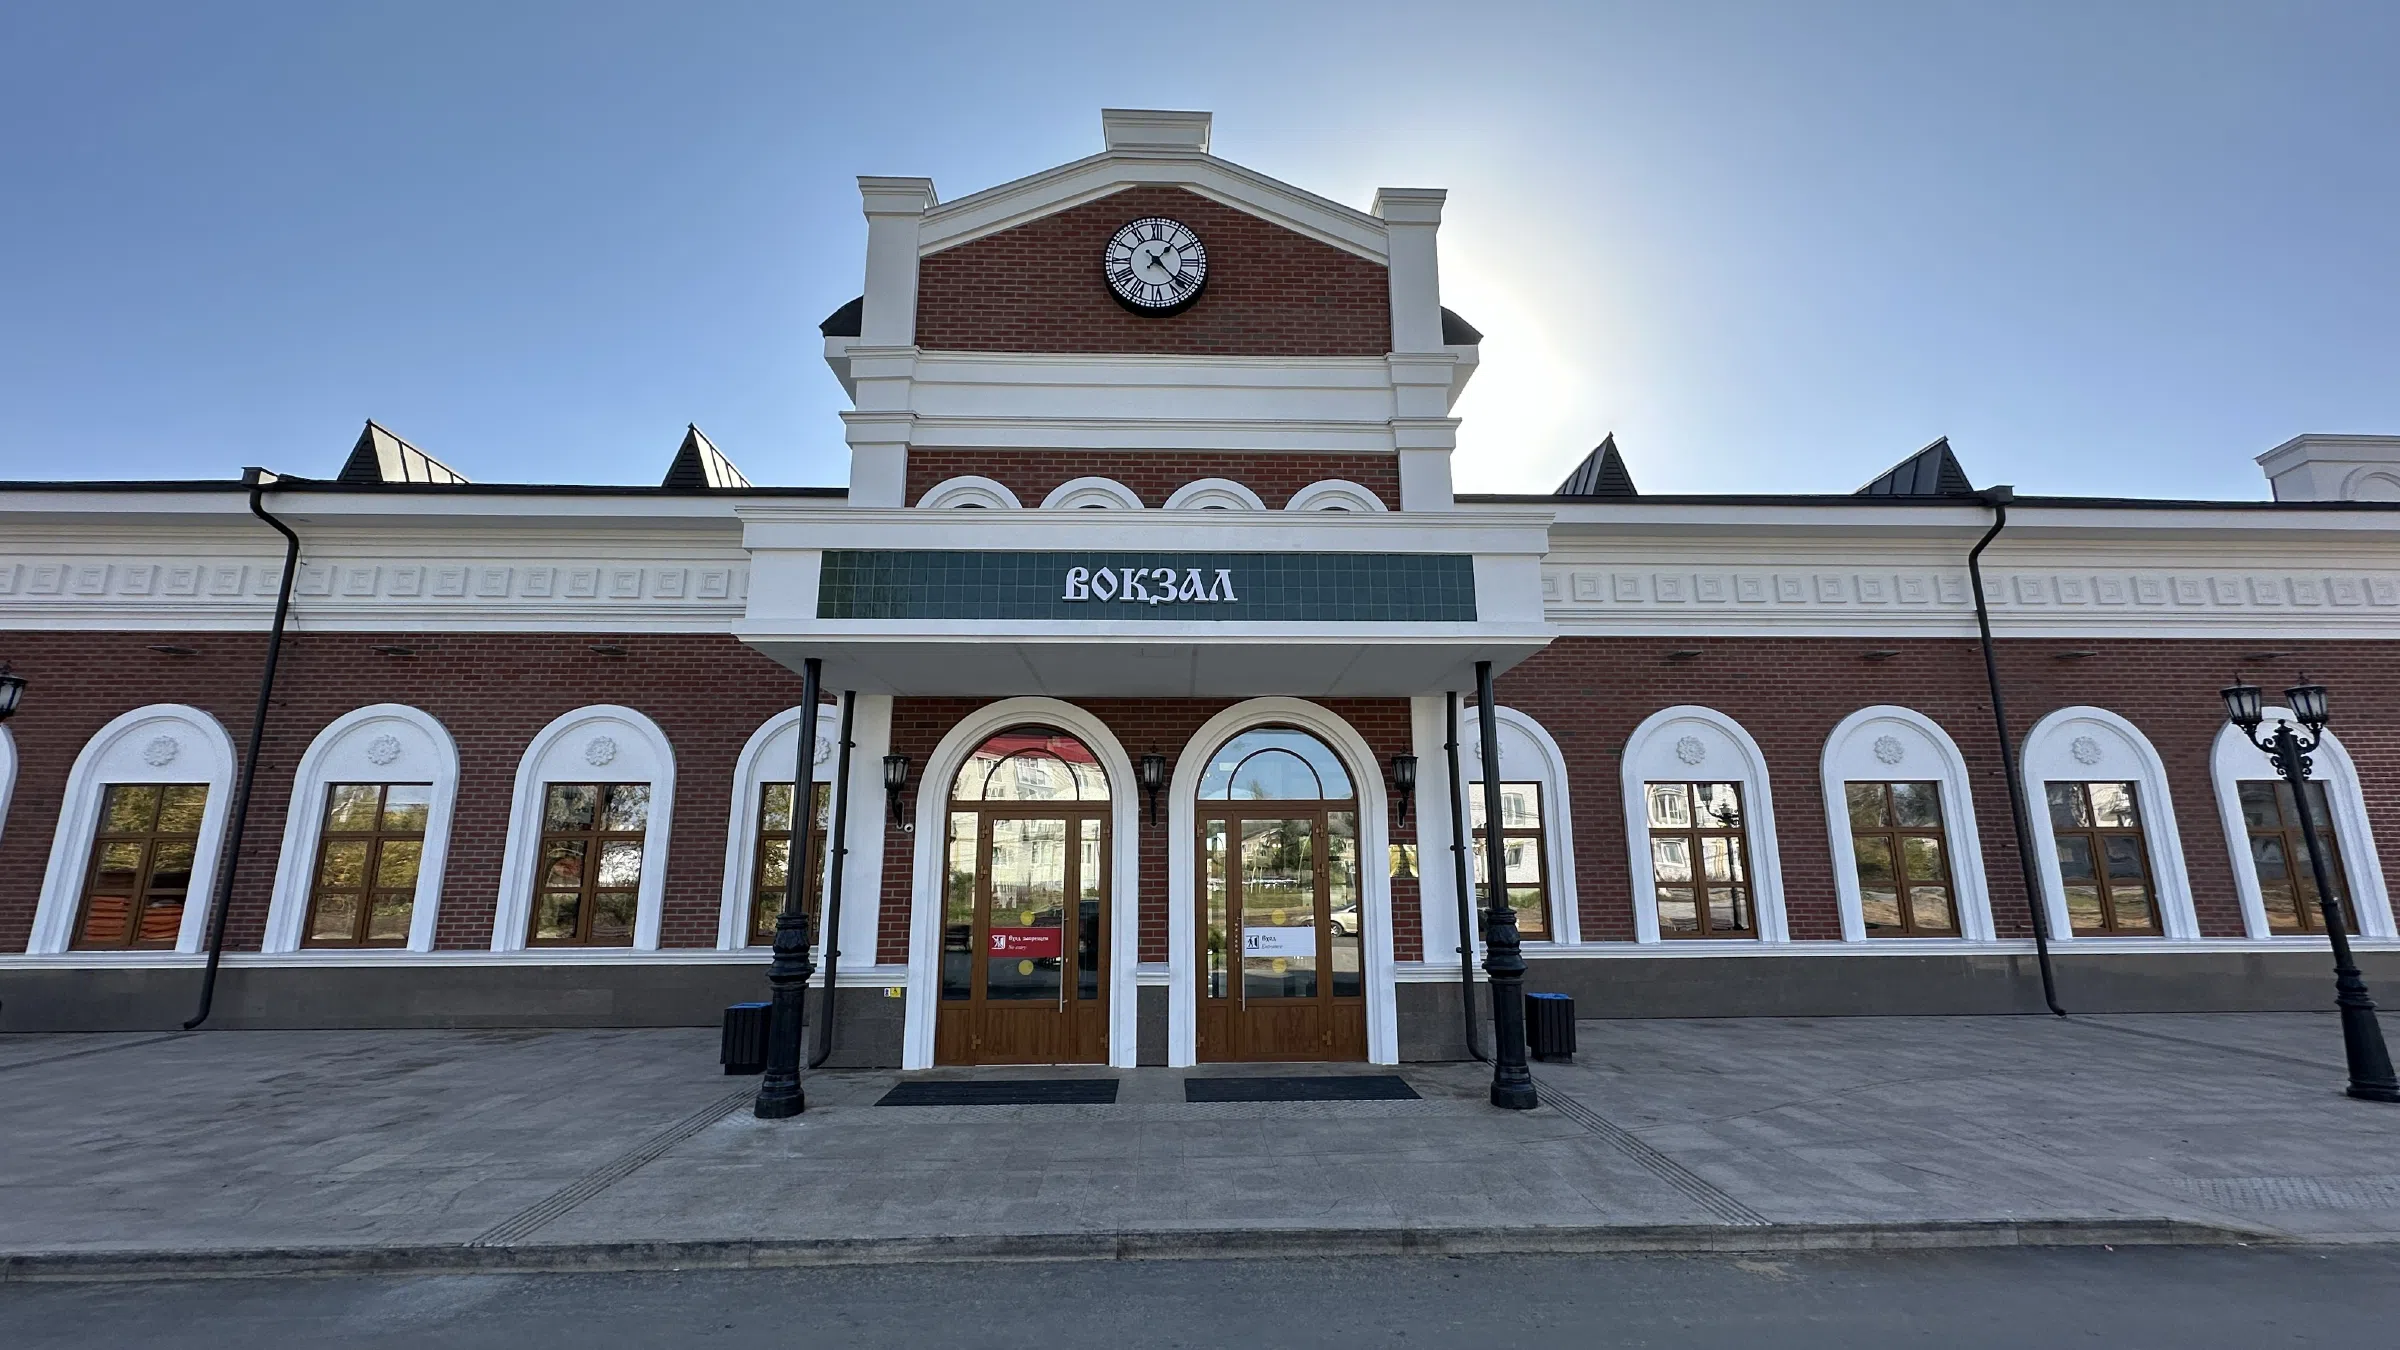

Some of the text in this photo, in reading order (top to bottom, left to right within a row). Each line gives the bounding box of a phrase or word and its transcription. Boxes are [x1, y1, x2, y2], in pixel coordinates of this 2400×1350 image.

[1151, 224, 1163, 240] XII
[1177, 241, 1195, 253] II
[1181, 259, 1199, 267] III
[1061, 566, 1239, 606] ВОКЗАЛ
